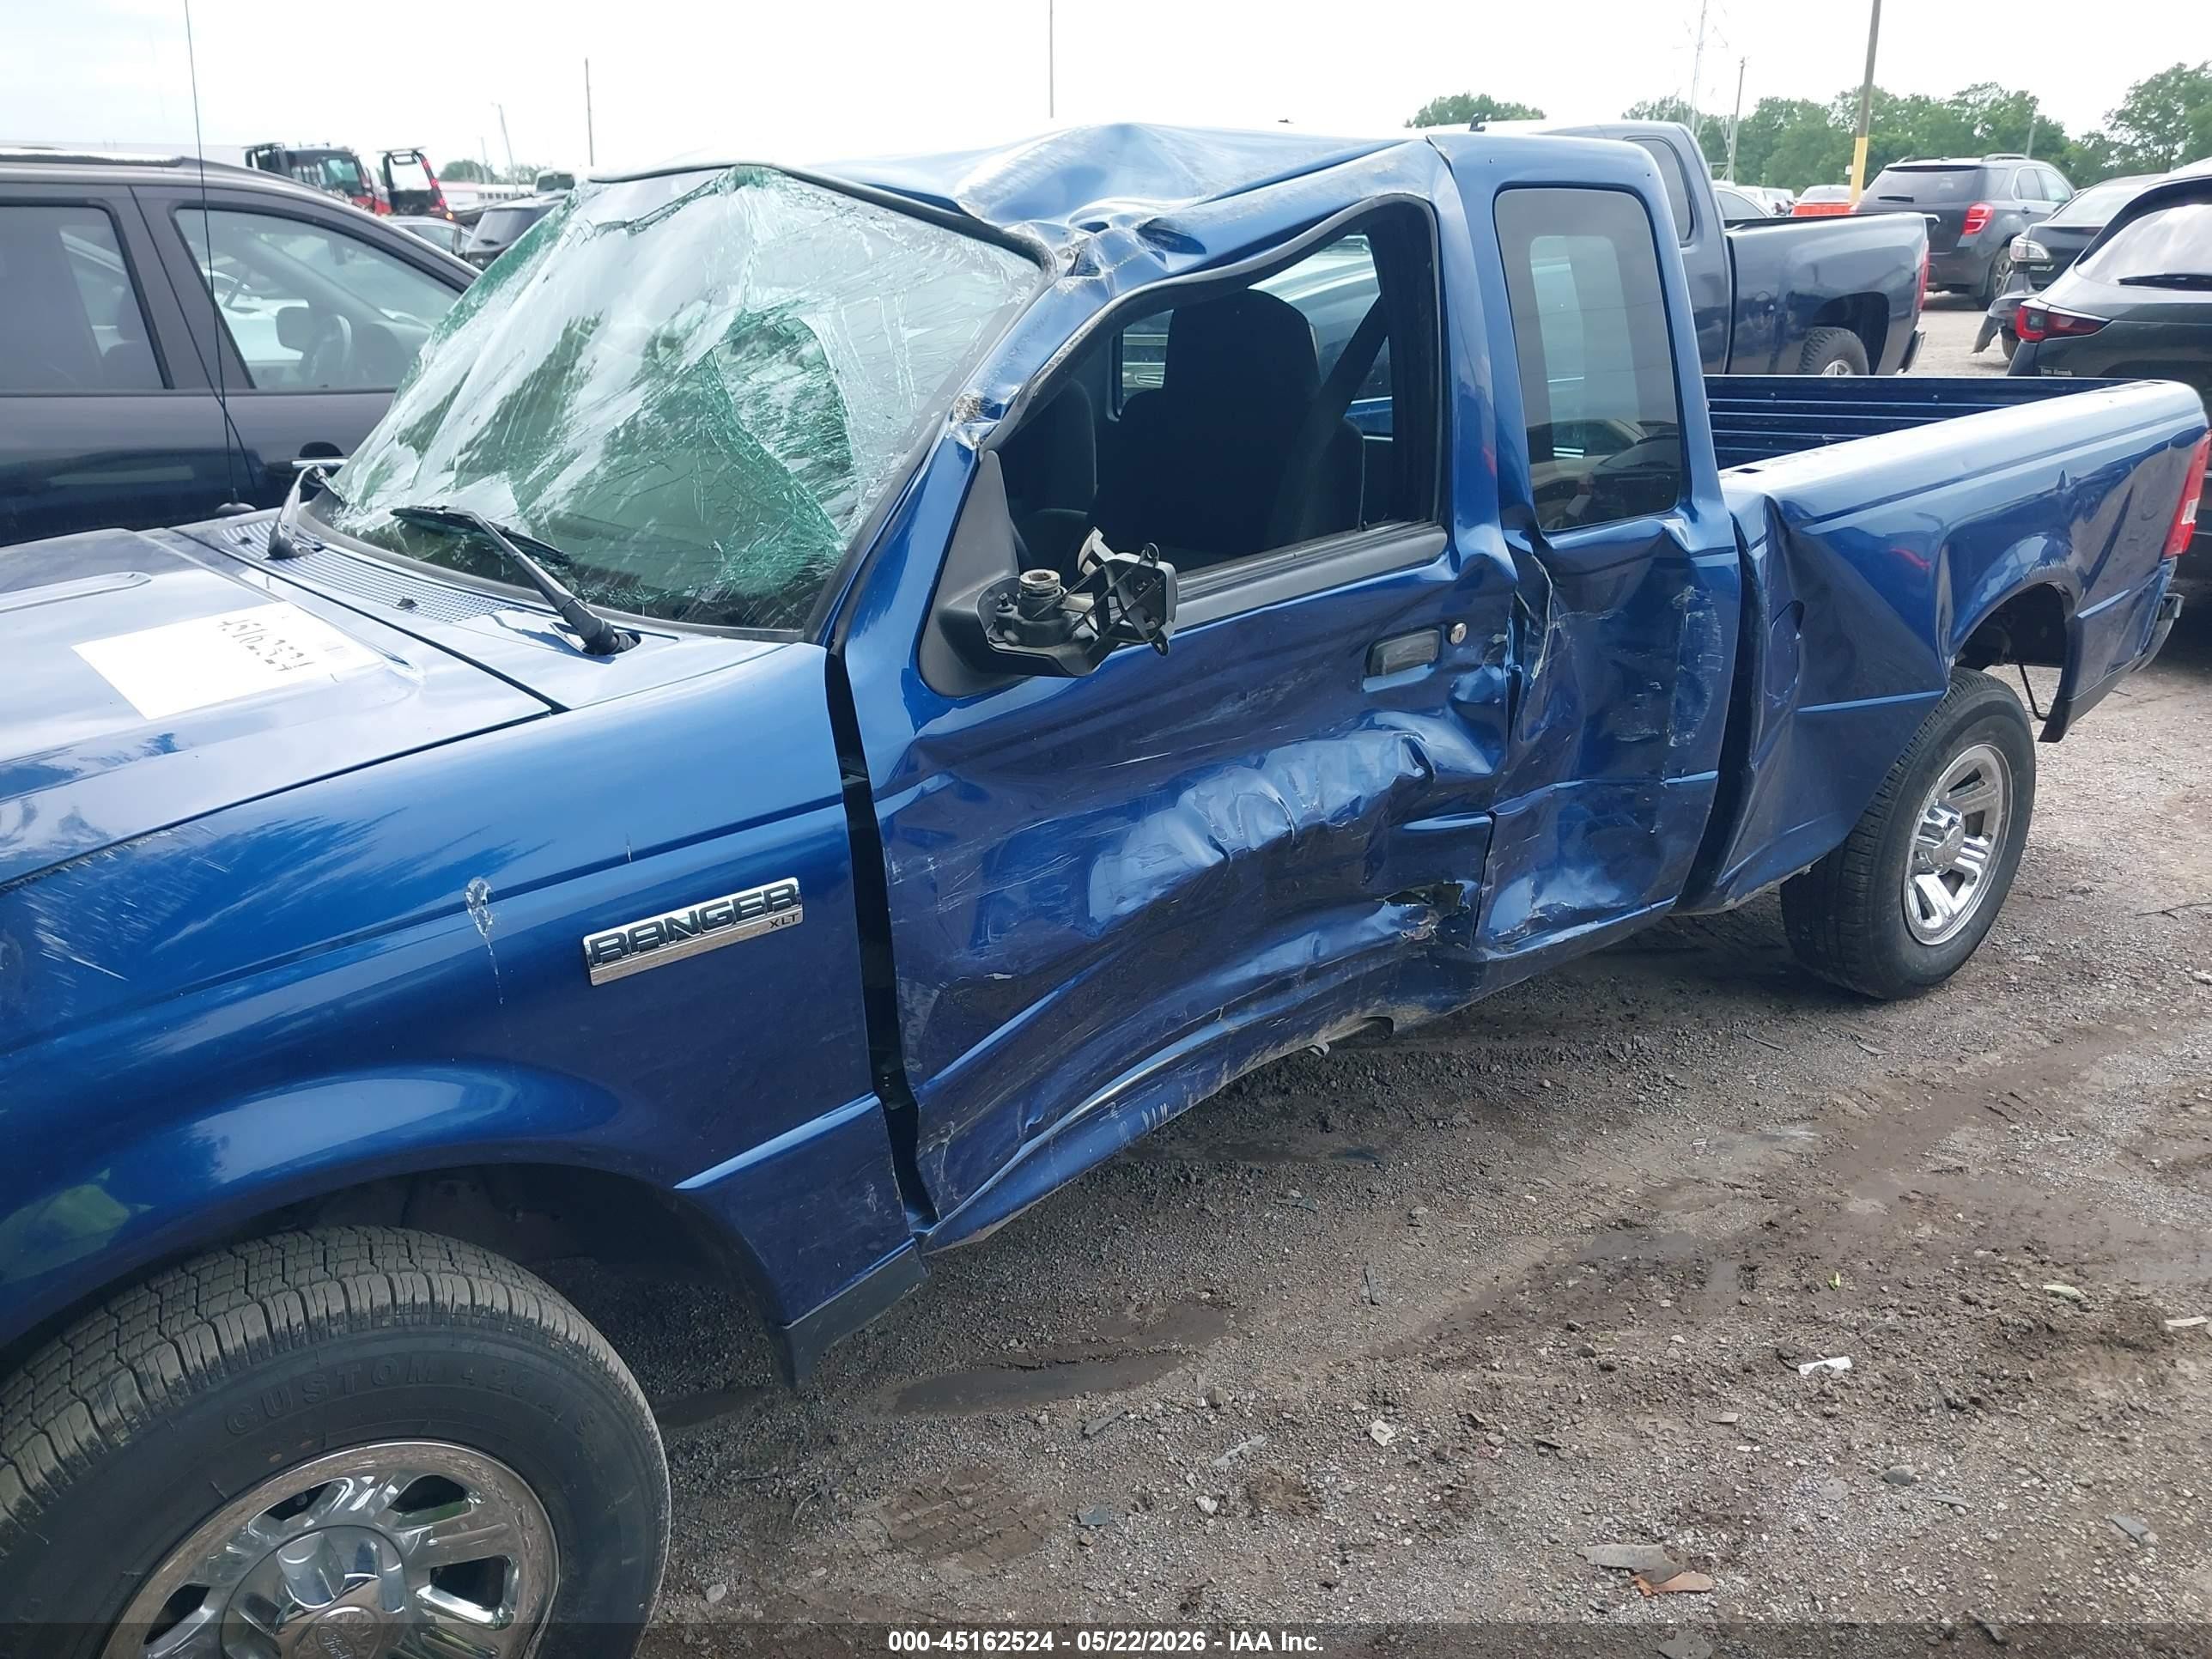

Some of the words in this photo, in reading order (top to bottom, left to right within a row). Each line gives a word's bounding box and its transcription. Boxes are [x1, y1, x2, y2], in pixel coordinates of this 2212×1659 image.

[589, 883, 800, 966] RANGER
[769, 913, 799, 929] XLT
[225, 1354, 437, 1435] CUSTOM
